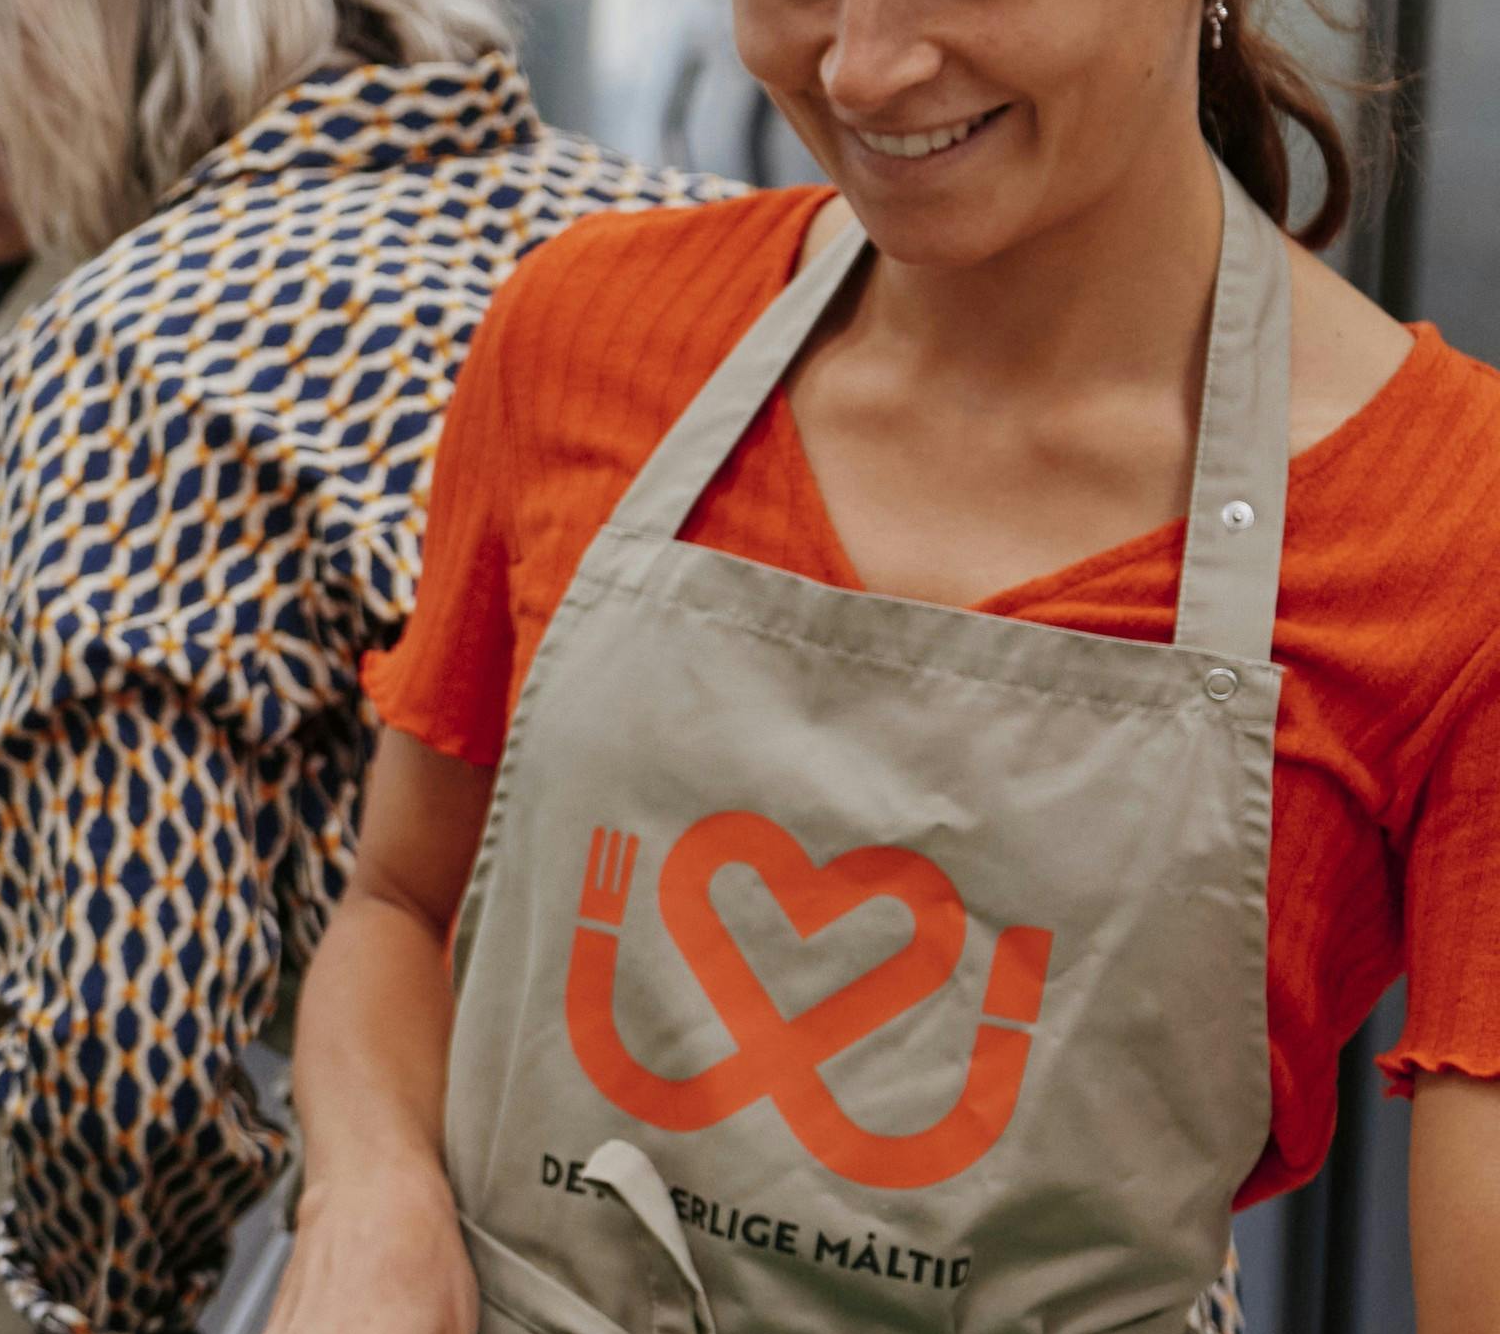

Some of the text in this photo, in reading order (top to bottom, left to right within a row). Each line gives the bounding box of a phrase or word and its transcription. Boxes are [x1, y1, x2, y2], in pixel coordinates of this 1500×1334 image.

[542, 1153, 971, 1290] DE RLIGE MÅLTID
